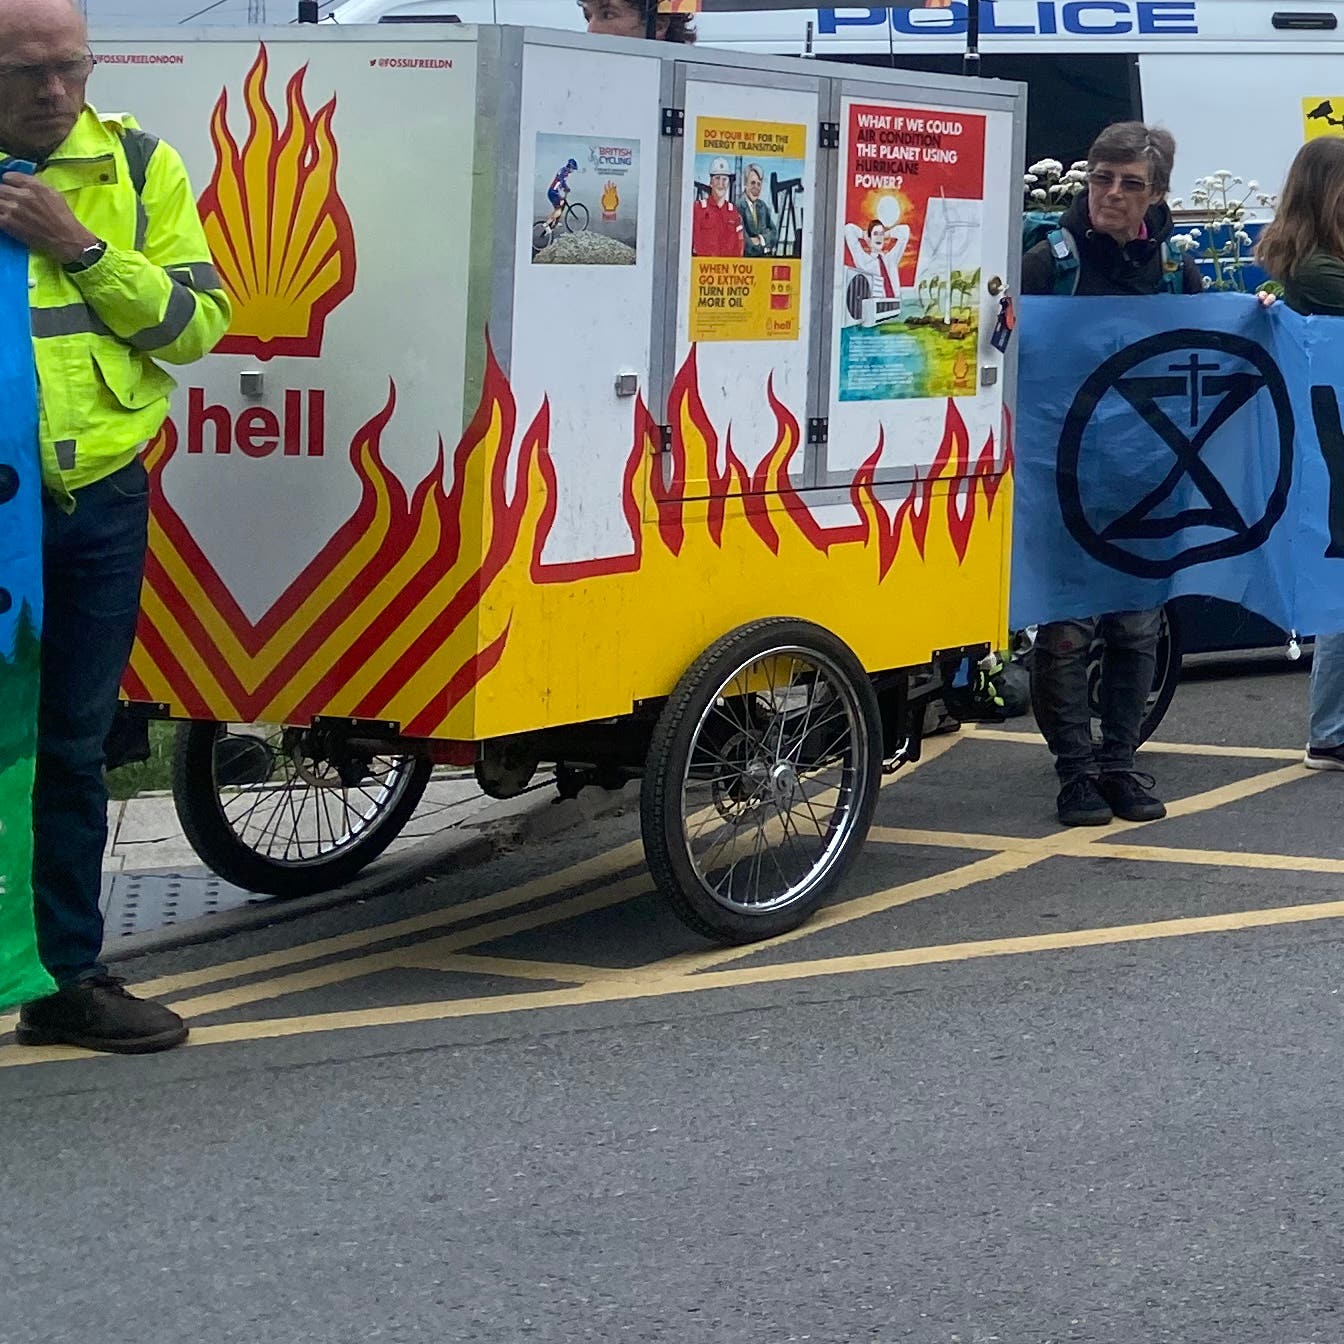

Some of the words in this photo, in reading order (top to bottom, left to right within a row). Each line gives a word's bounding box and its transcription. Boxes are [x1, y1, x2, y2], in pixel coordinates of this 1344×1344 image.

[818, 0, 1199, 35] POLICE
[857, 114, 892, 129] WHAT
[894, 117, 904, 130] IF
[906, 119, 925, 132] WE
[926, 120, 963, 135] COULD
[704, 129, 717, 139] DO
[719, 129, 742, 140] YOUR
[857, 129, 876, 143] AIR
[880, 131, 941, 147] CONDITION
[599, 146, 632, 157] BRITISH
[703, 139, 736, 150] ENERGY
[738, 141, 784, 152] TRANSITION
[599, 155, 632, 166] CYCLING
[856, 144, 877, 158] THE
[880, 145, 920, 161] PLANET
[922, 149, 958, 164] USING
[855, 160, 919, 175] HURRICANE
[855, 174, 903, 189] POWER?
[698, 263, 729, 274] WHEN
[732, 264, 753, 275] YOU
[698, 275, 714, 285] GO
[699, 286, 724, 296] TURN
[727, 286, 750, 296] INTO
[697, 297, 725, 308] MORE
[728, 297, 744, 308] OIL
[188, 387, 325, 458] hell
